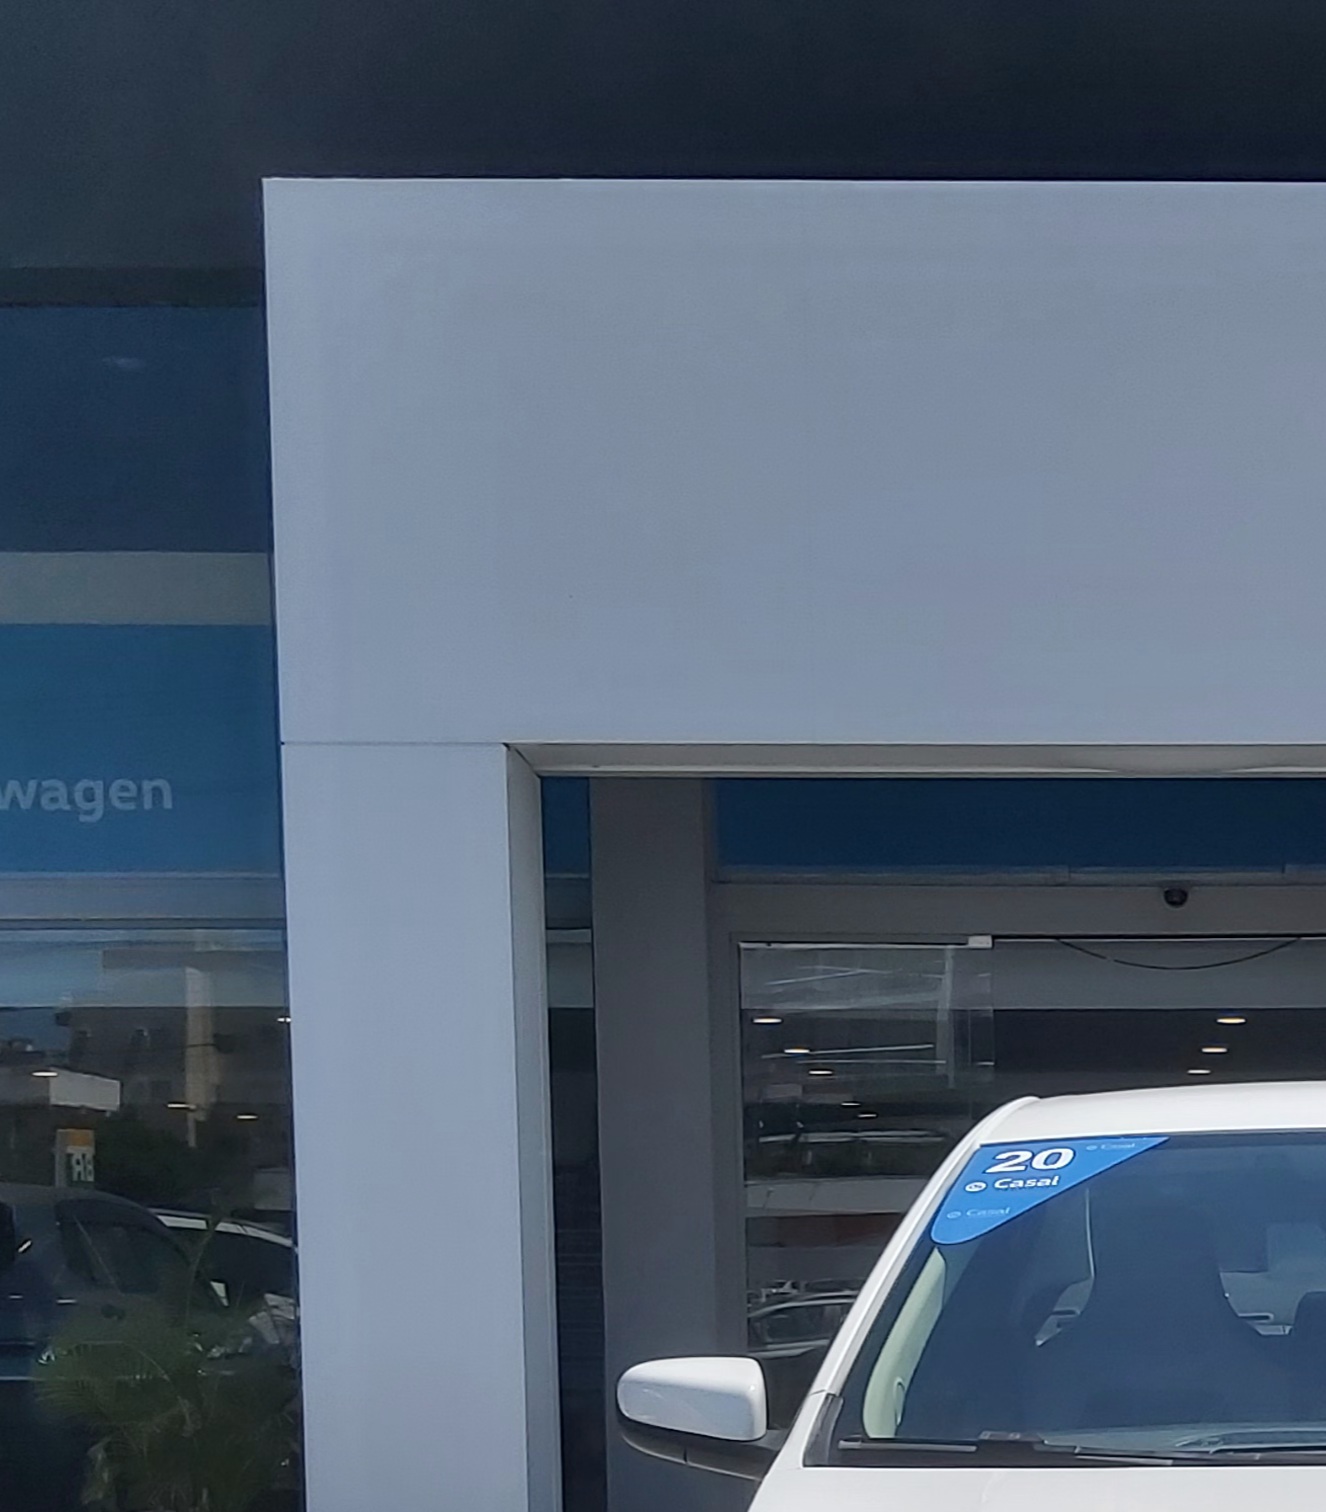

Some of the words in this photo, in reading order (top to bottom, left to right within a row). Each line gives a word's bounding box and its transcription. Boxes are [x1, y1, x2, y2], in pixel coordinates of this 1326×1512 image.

[0, 777, 174, 823] wagen
[984, 1147, 1075, 1174] 20
[993, 1175, 1061, 1190] Casal
